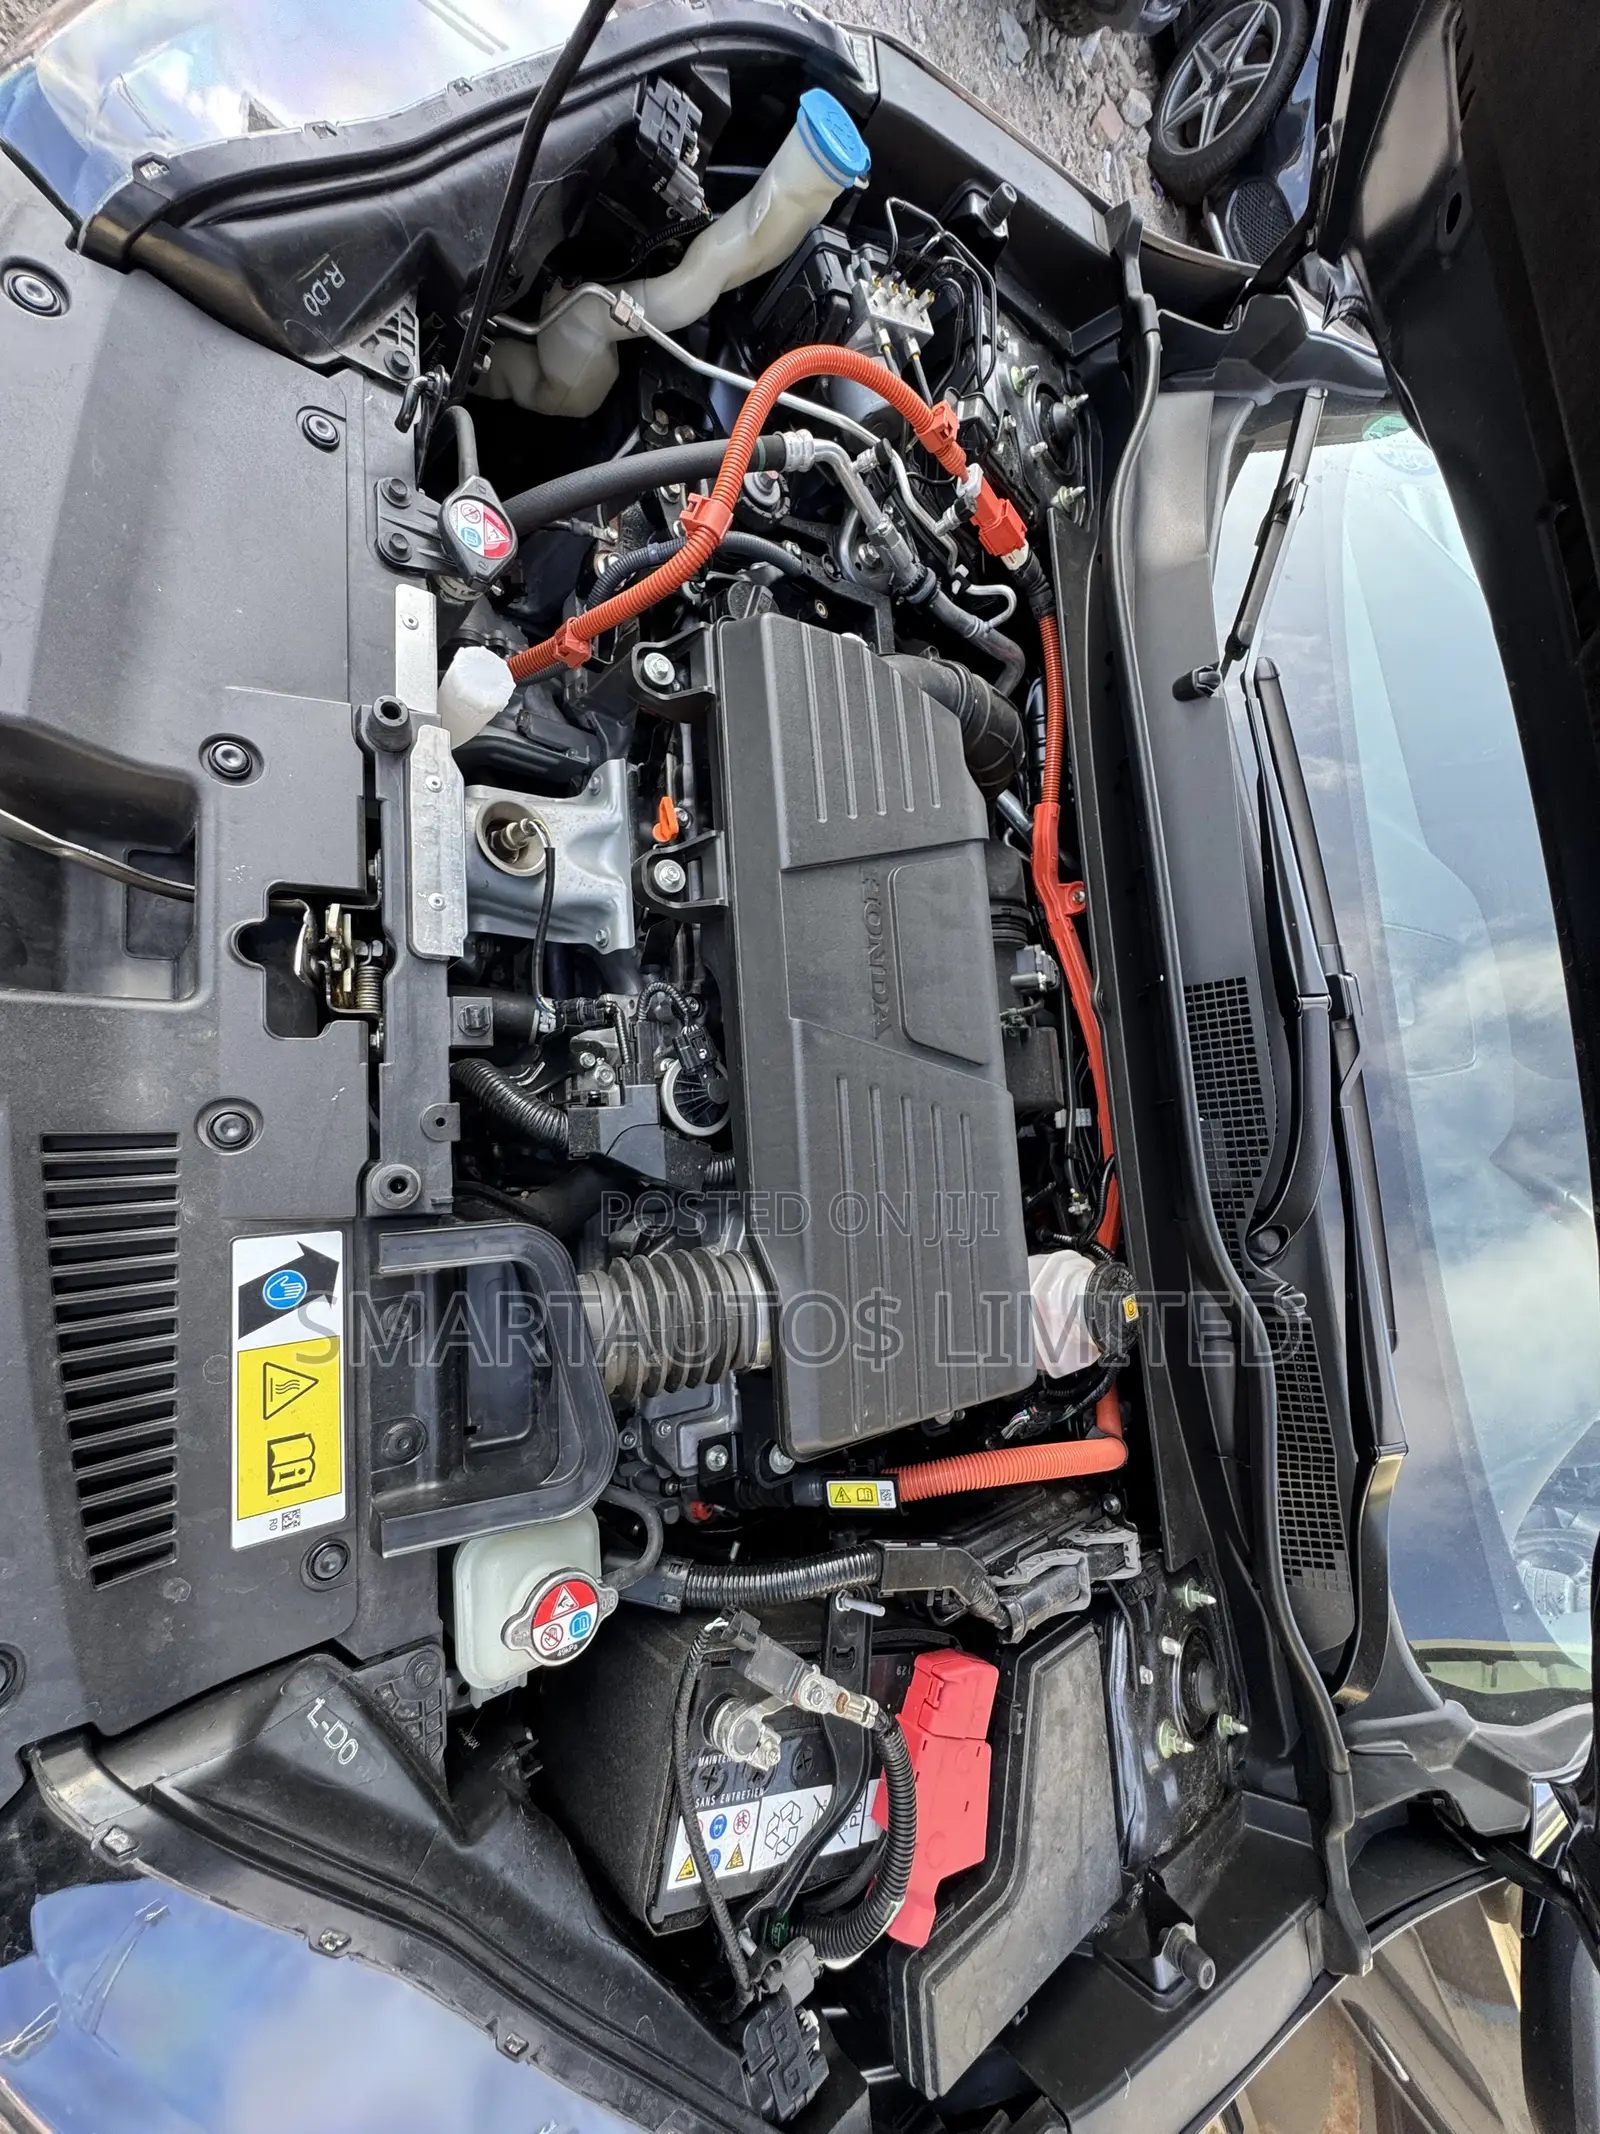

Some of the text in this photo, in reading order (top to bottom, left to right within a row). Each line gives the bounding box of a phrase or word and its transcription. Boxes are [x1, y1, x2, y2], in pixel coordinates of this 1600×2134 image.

[858, 865, 892, 1040] HONDA
[556, 1644, 578, 1657] 49kPa
[694, 1787, 765, 1808] SANS ENTRETIEN
